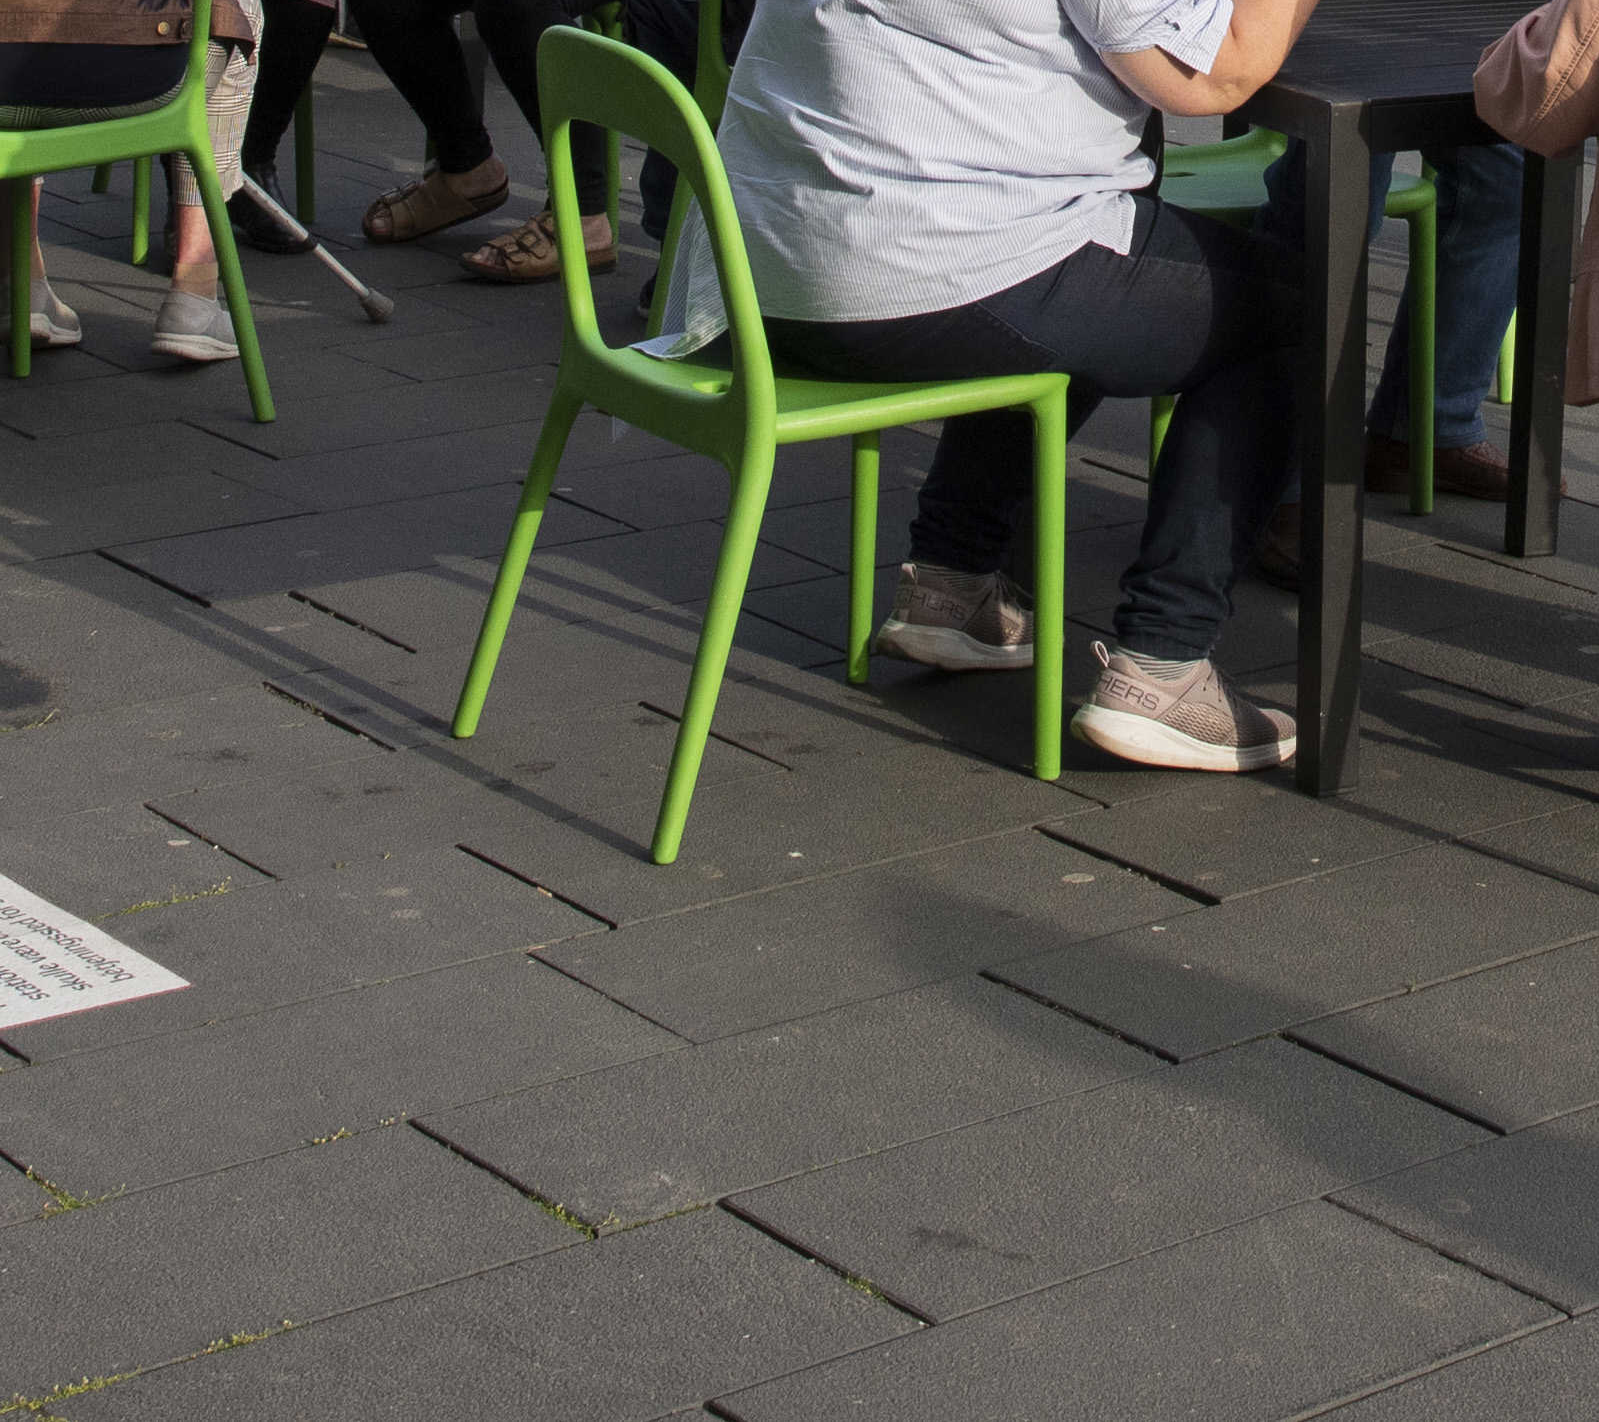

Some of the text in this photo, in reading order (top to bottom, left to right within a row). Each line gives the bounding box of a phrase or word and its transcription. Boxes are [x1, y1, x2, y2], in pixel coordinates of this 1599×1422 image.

[1, 939, 46, 963] være
[10, 918, 135, 983] betjeningssted
[39, 963, 93, 991] skulle
